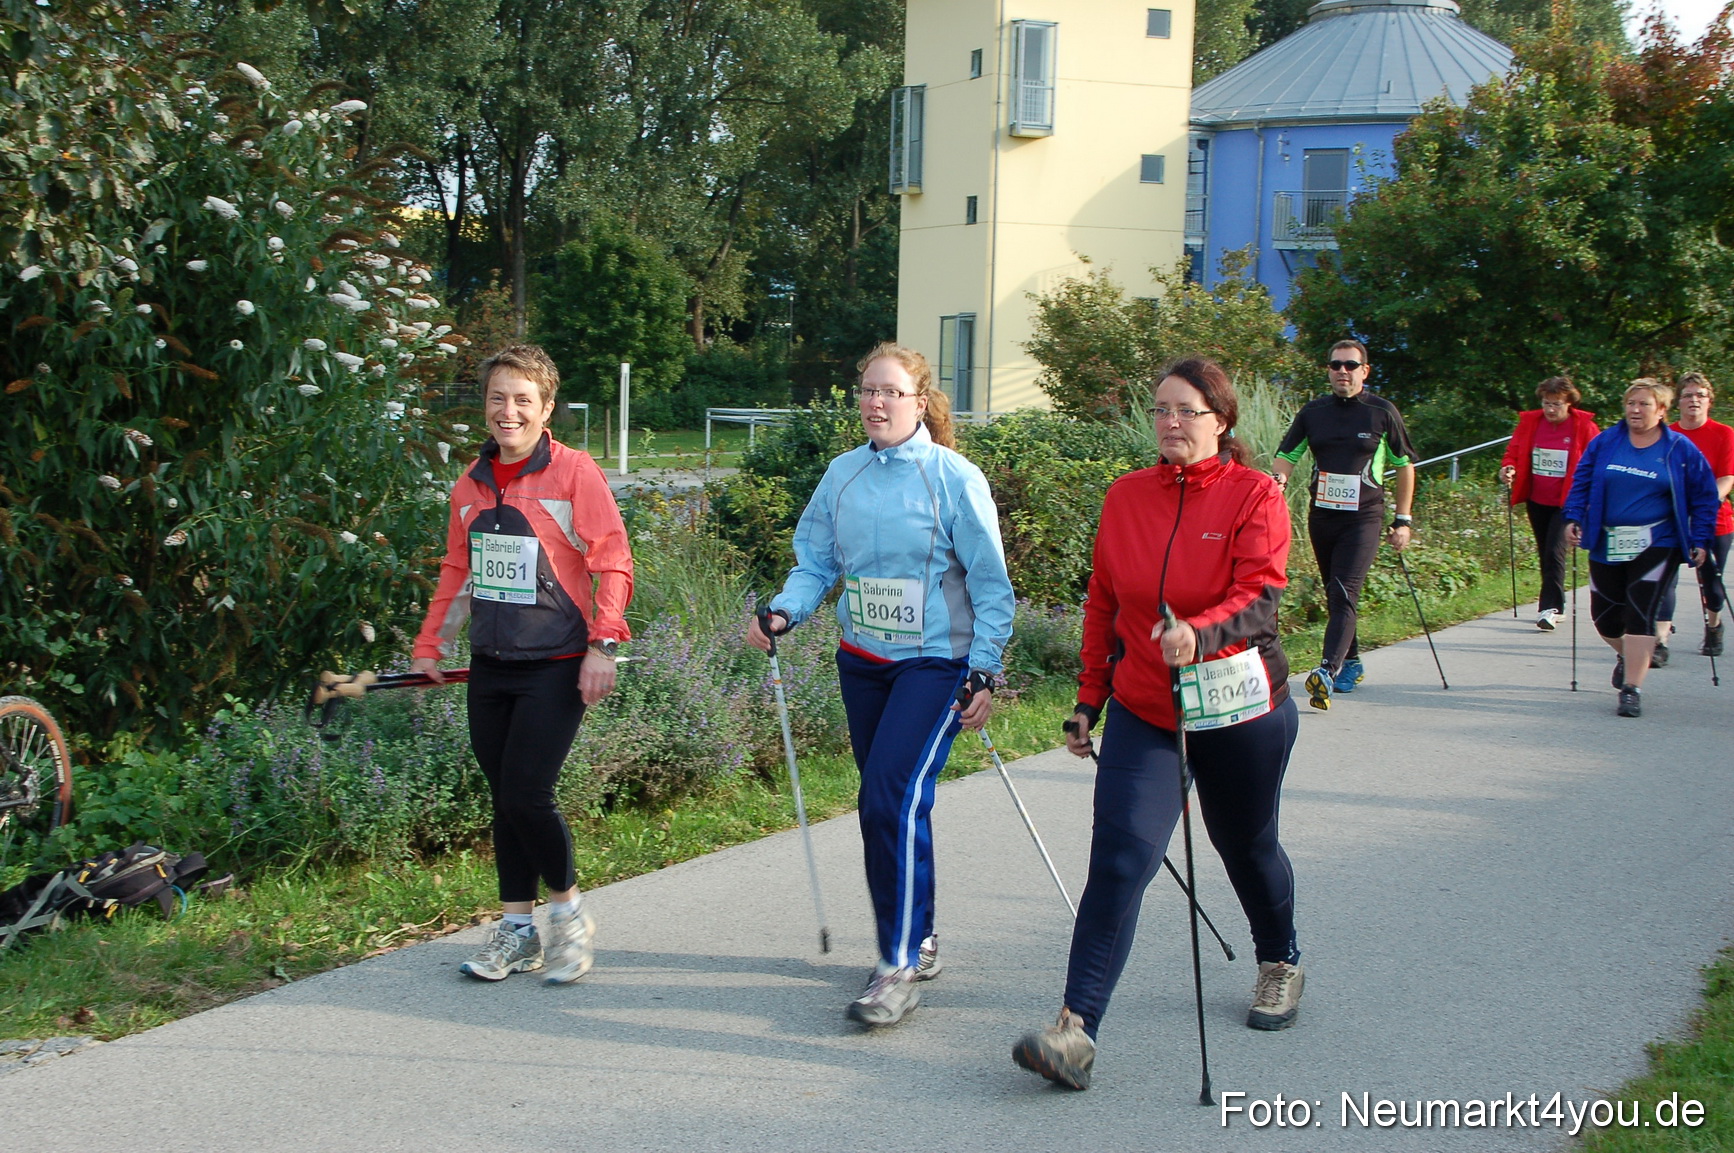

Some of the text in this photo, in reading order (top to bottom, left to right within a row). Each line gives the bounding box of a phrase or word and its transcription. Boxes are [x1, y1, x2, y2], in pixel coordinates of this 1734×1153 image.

[1541, 459, 1564, 469] 8053
[1328, 475, 1346, 485] Bernd
[1327, 487, 1356, 499] 8052
[485, 538, 521, 554] Gabriele
[1618, 538, 1647, 549] 8093
[486, 560, 527, 581] 8051
[863, 582, 903, 597] Sabrina
[867, 602, 915, 624] 8043
[1203, 661, 1250, 681] Jeanette
[1207, 676, 1262, 707] 8042
